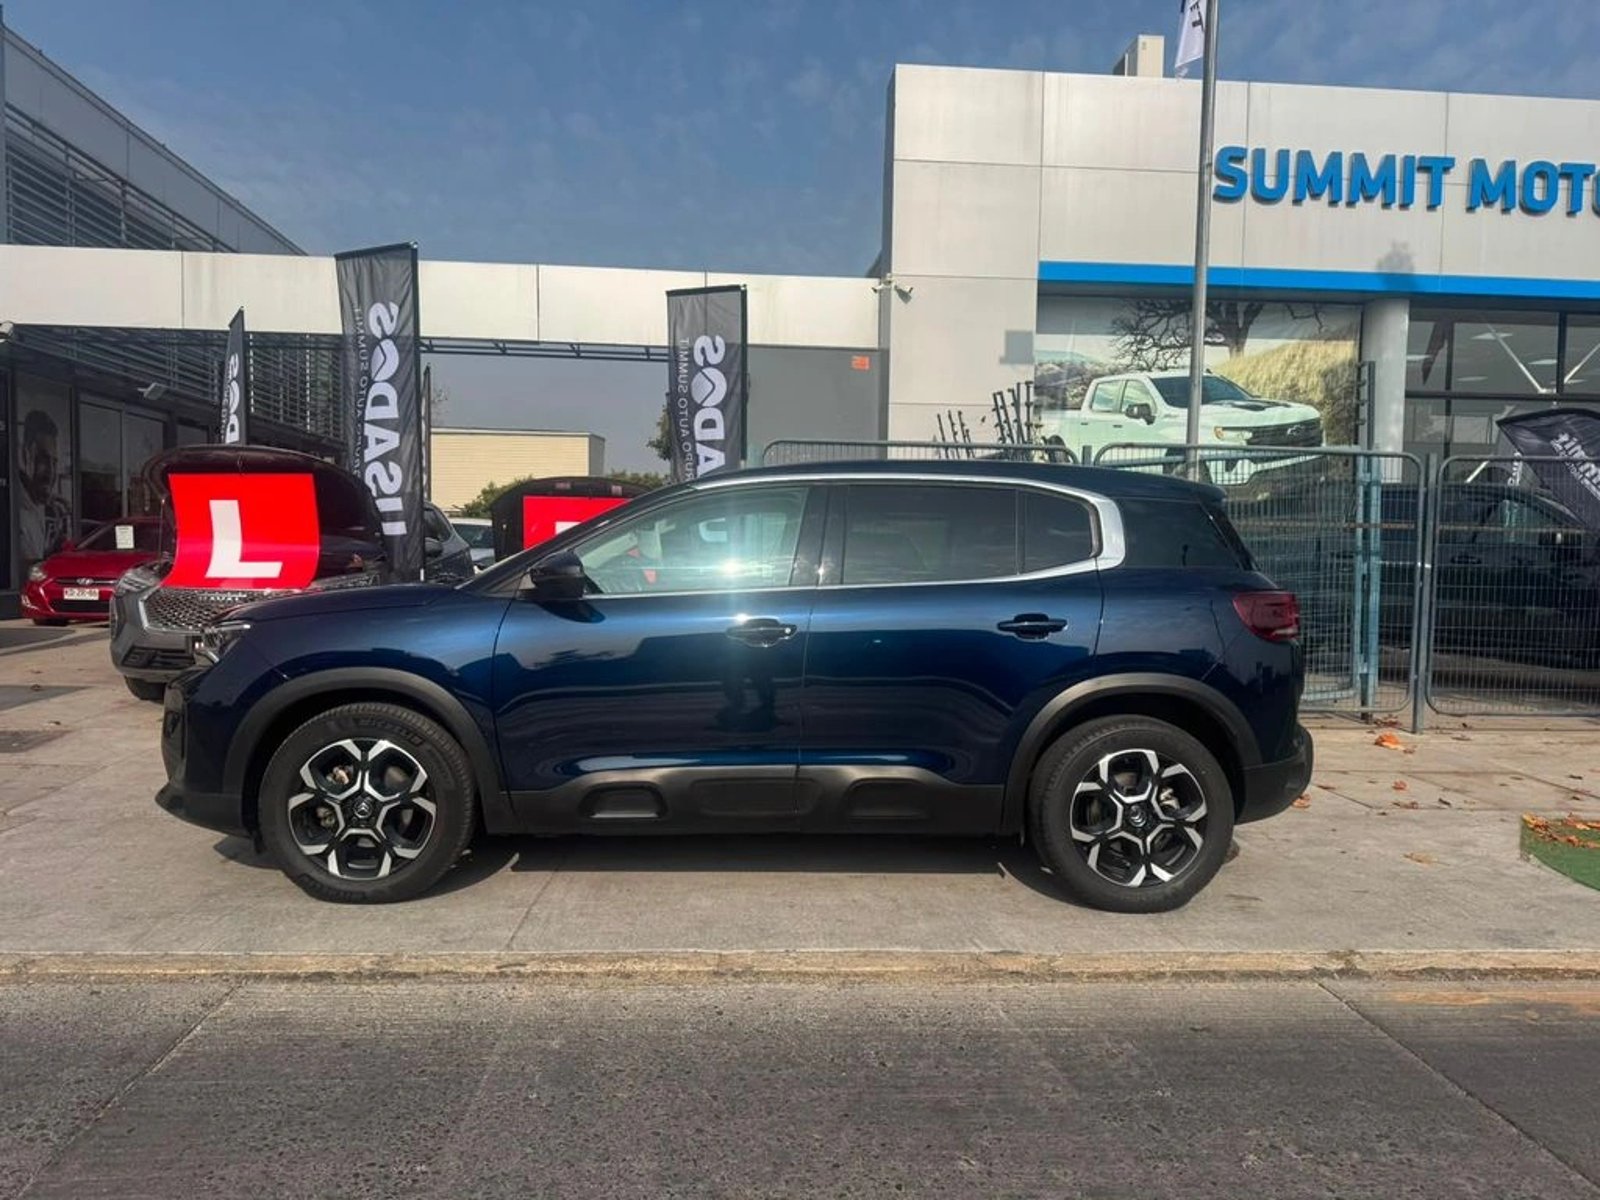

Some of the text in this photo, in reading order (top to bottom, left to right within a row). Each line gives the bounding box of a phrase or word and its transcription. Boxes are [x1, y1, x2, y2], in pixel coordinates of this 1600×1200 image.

[1213, 146, 1600, 217] SUMMIT MOT
[204, 500, 283, 578] L
